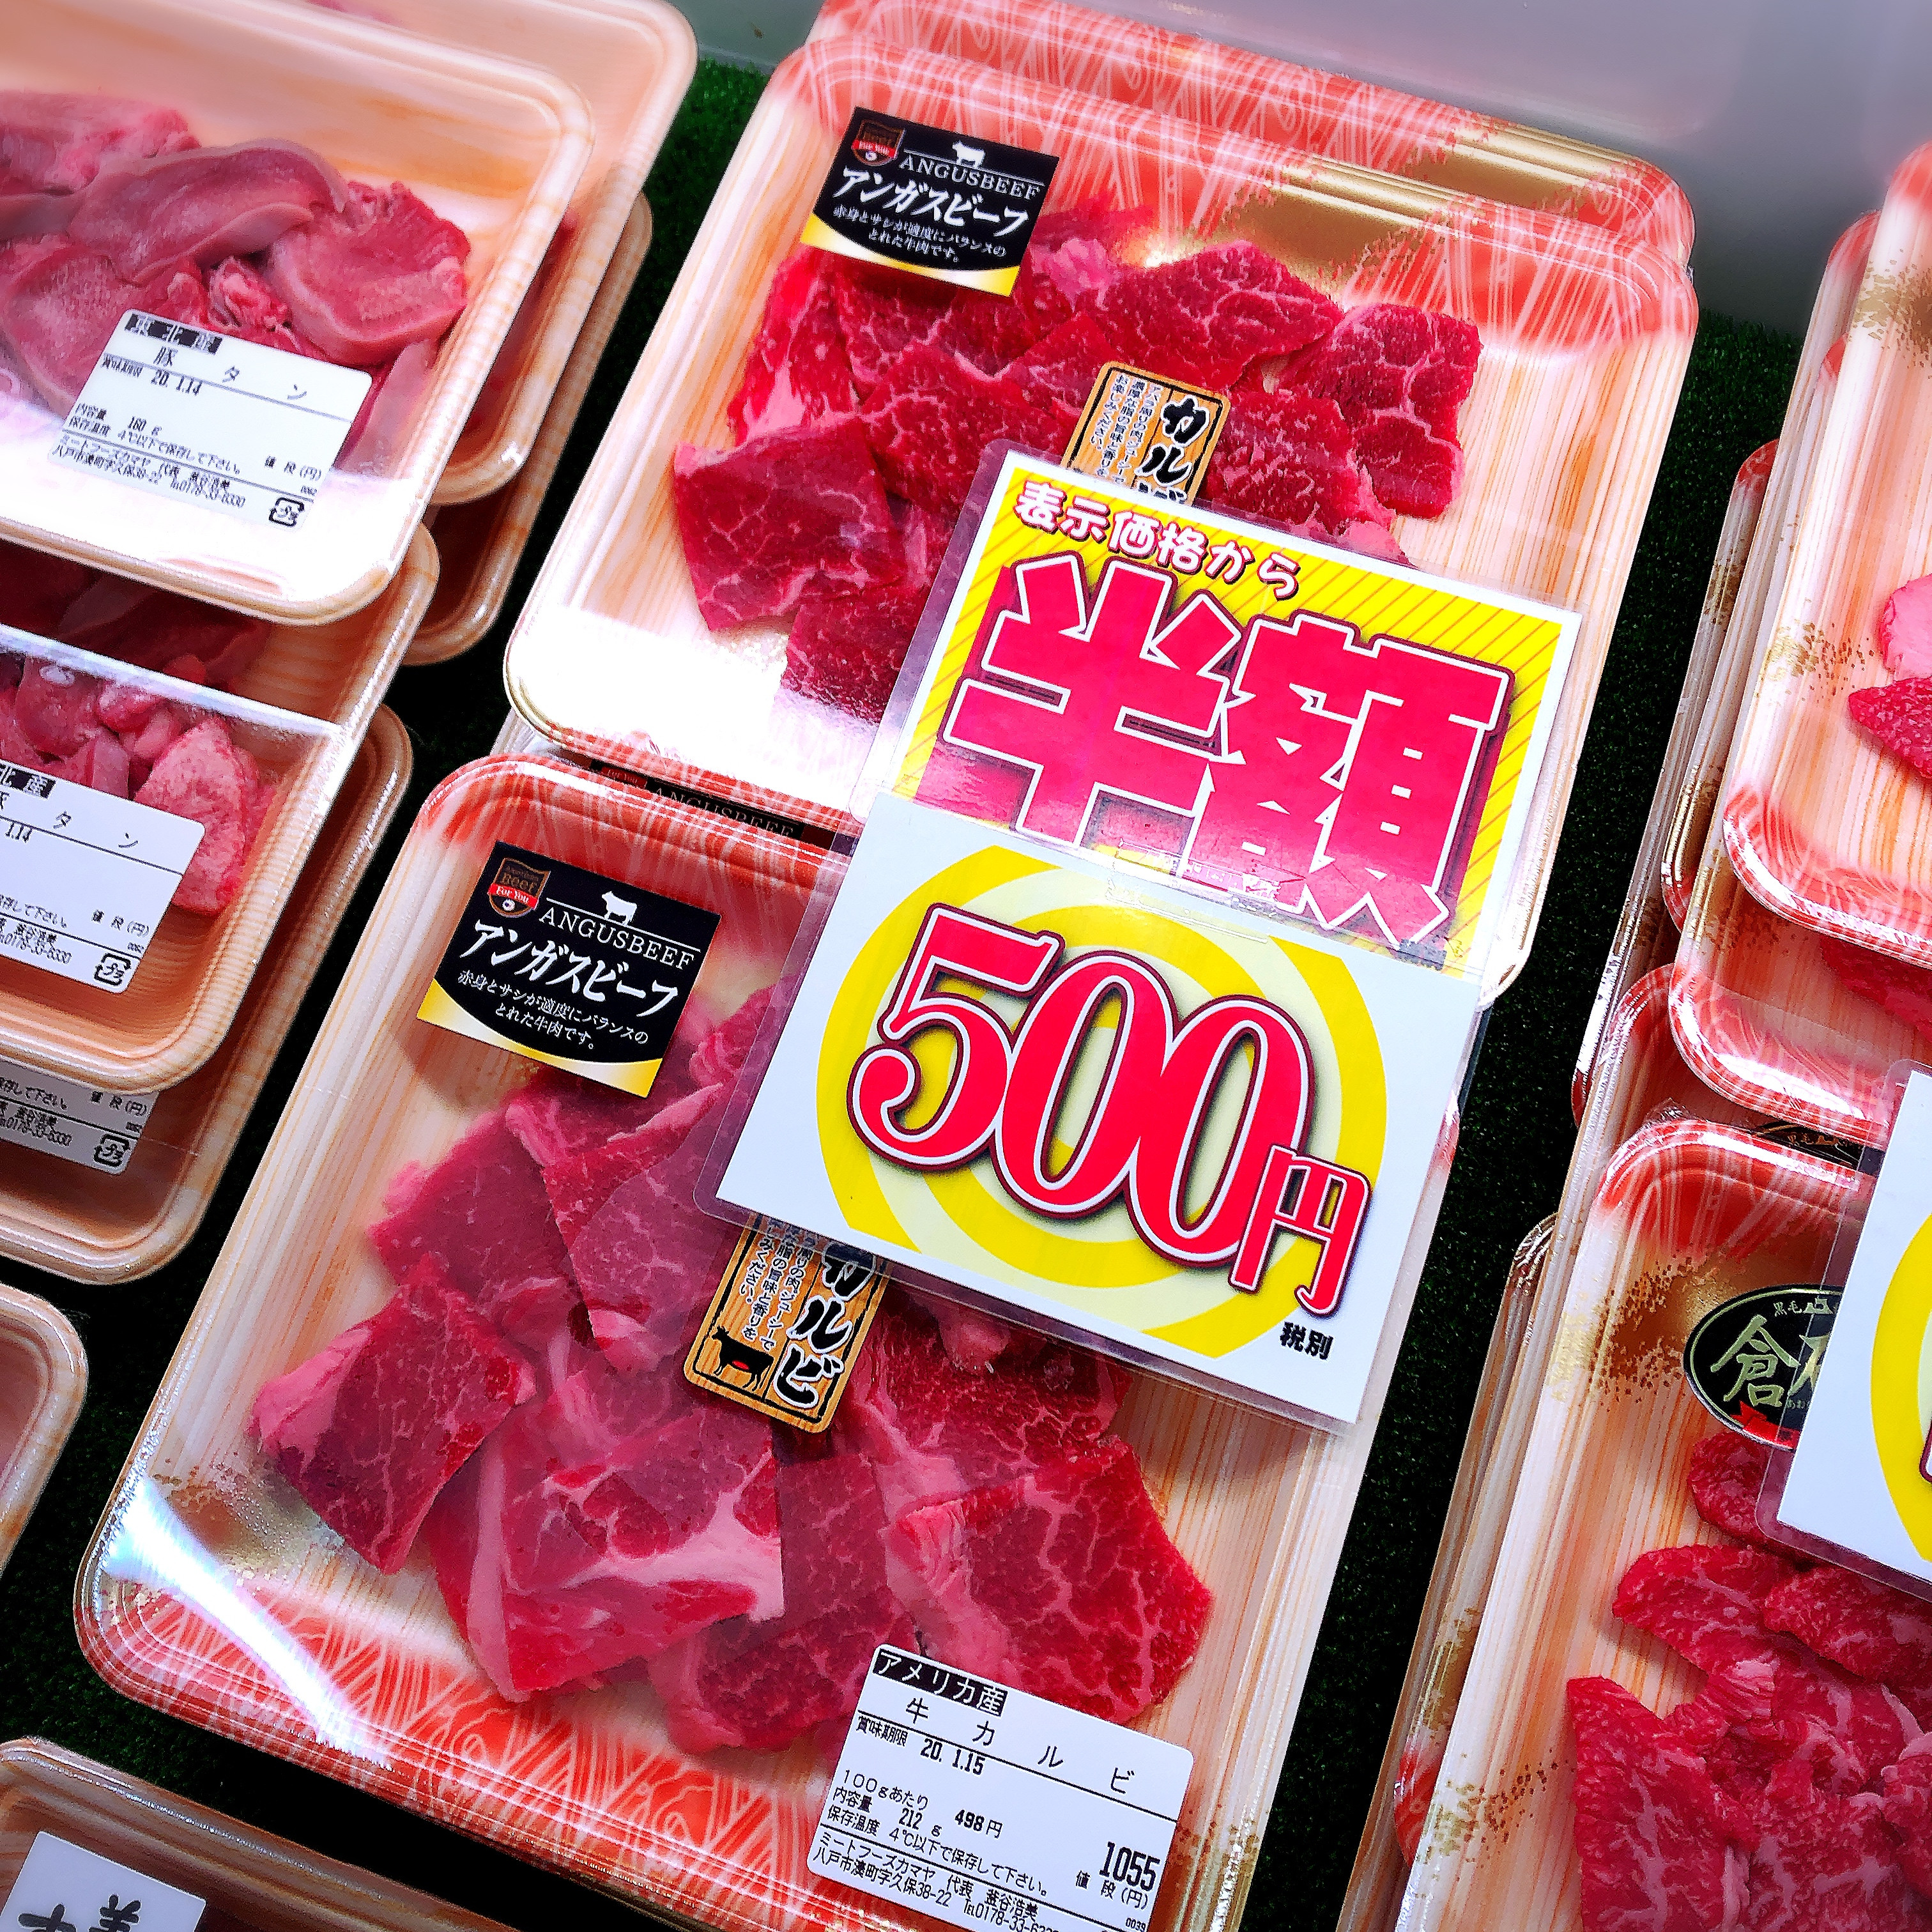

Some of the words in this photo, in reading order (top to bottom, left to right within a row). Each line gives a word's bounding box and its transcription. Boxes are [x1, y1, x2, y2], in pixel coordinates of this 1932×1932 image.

[832, 165, 1030, 238] アンガスビーフ
[898, 155, 1041, 201] ANGUSBEEF
[1016, 480, 1302, 601] 表示価格から
[941, 549, 1517, 949] 半額
[459, 919, 679, 1018] アンガスビーフ
[538, 906, 696, 971] ANGUSBEEF
[457, 969, 650, 1046] 赤身とサシが適度にバランスの
[494, 1001, 596, 1051] とれた牛肉です。
[1279, 1320, 1335, 1361] 税別
[877, 1650, 1006, 1717] アメリカ産
[855, 1715, 908, 1747] 賞味期限
[827, 1804, 881, 1837] 保存温度
[843, 1769, 929, 1811] 100gあたり
[820, 1831, 936, 1882] ミートフーズカマヤ
[946, 1873, 974, 1899] 代表
[832, 1786, 873, 1813] 内容量
[898, 1807, 923, 1830] 212
[1099, 1841, 1161, 1892] 1055
